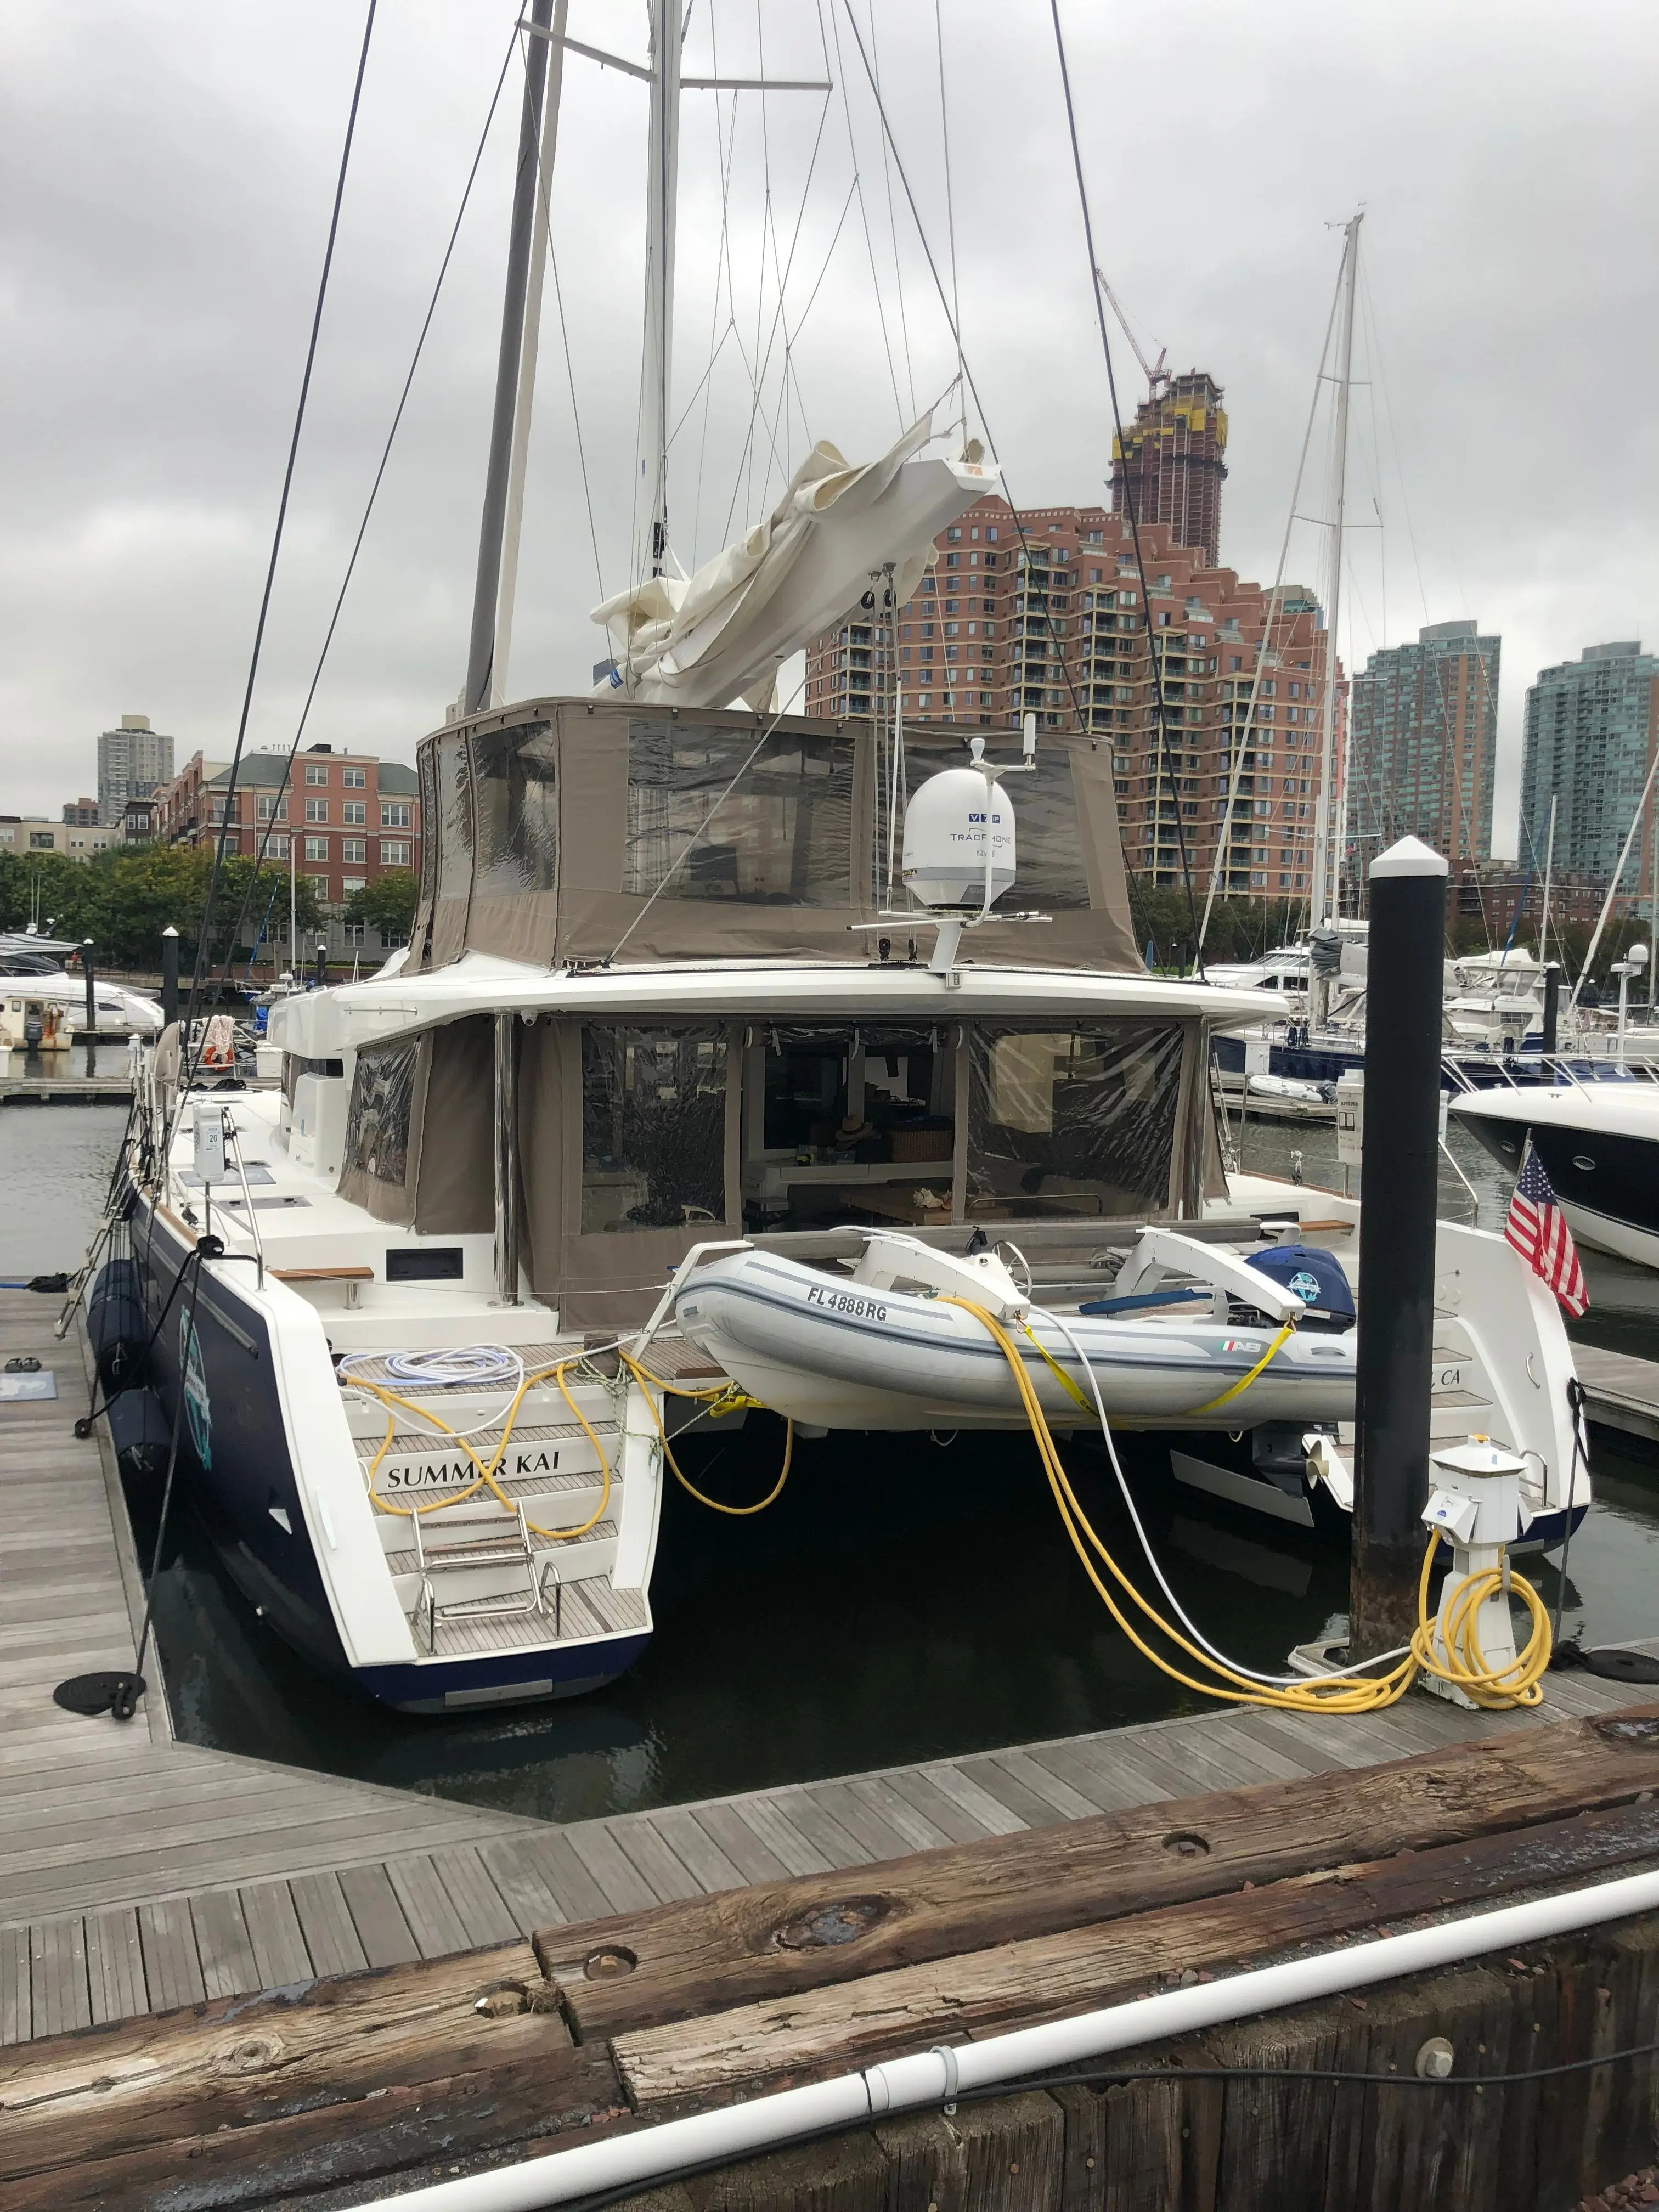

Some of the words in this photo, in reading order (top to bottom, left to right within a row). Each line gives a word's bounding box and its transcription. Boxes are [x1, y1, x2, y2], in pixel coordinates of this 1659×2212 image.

[209, 1134, 218, 1143] 20
[1441, 1369, 1460, 1385] CA
[387, 1458, 507, 1488] SUMMER
[516, 1451, 560, 1474] KAI
